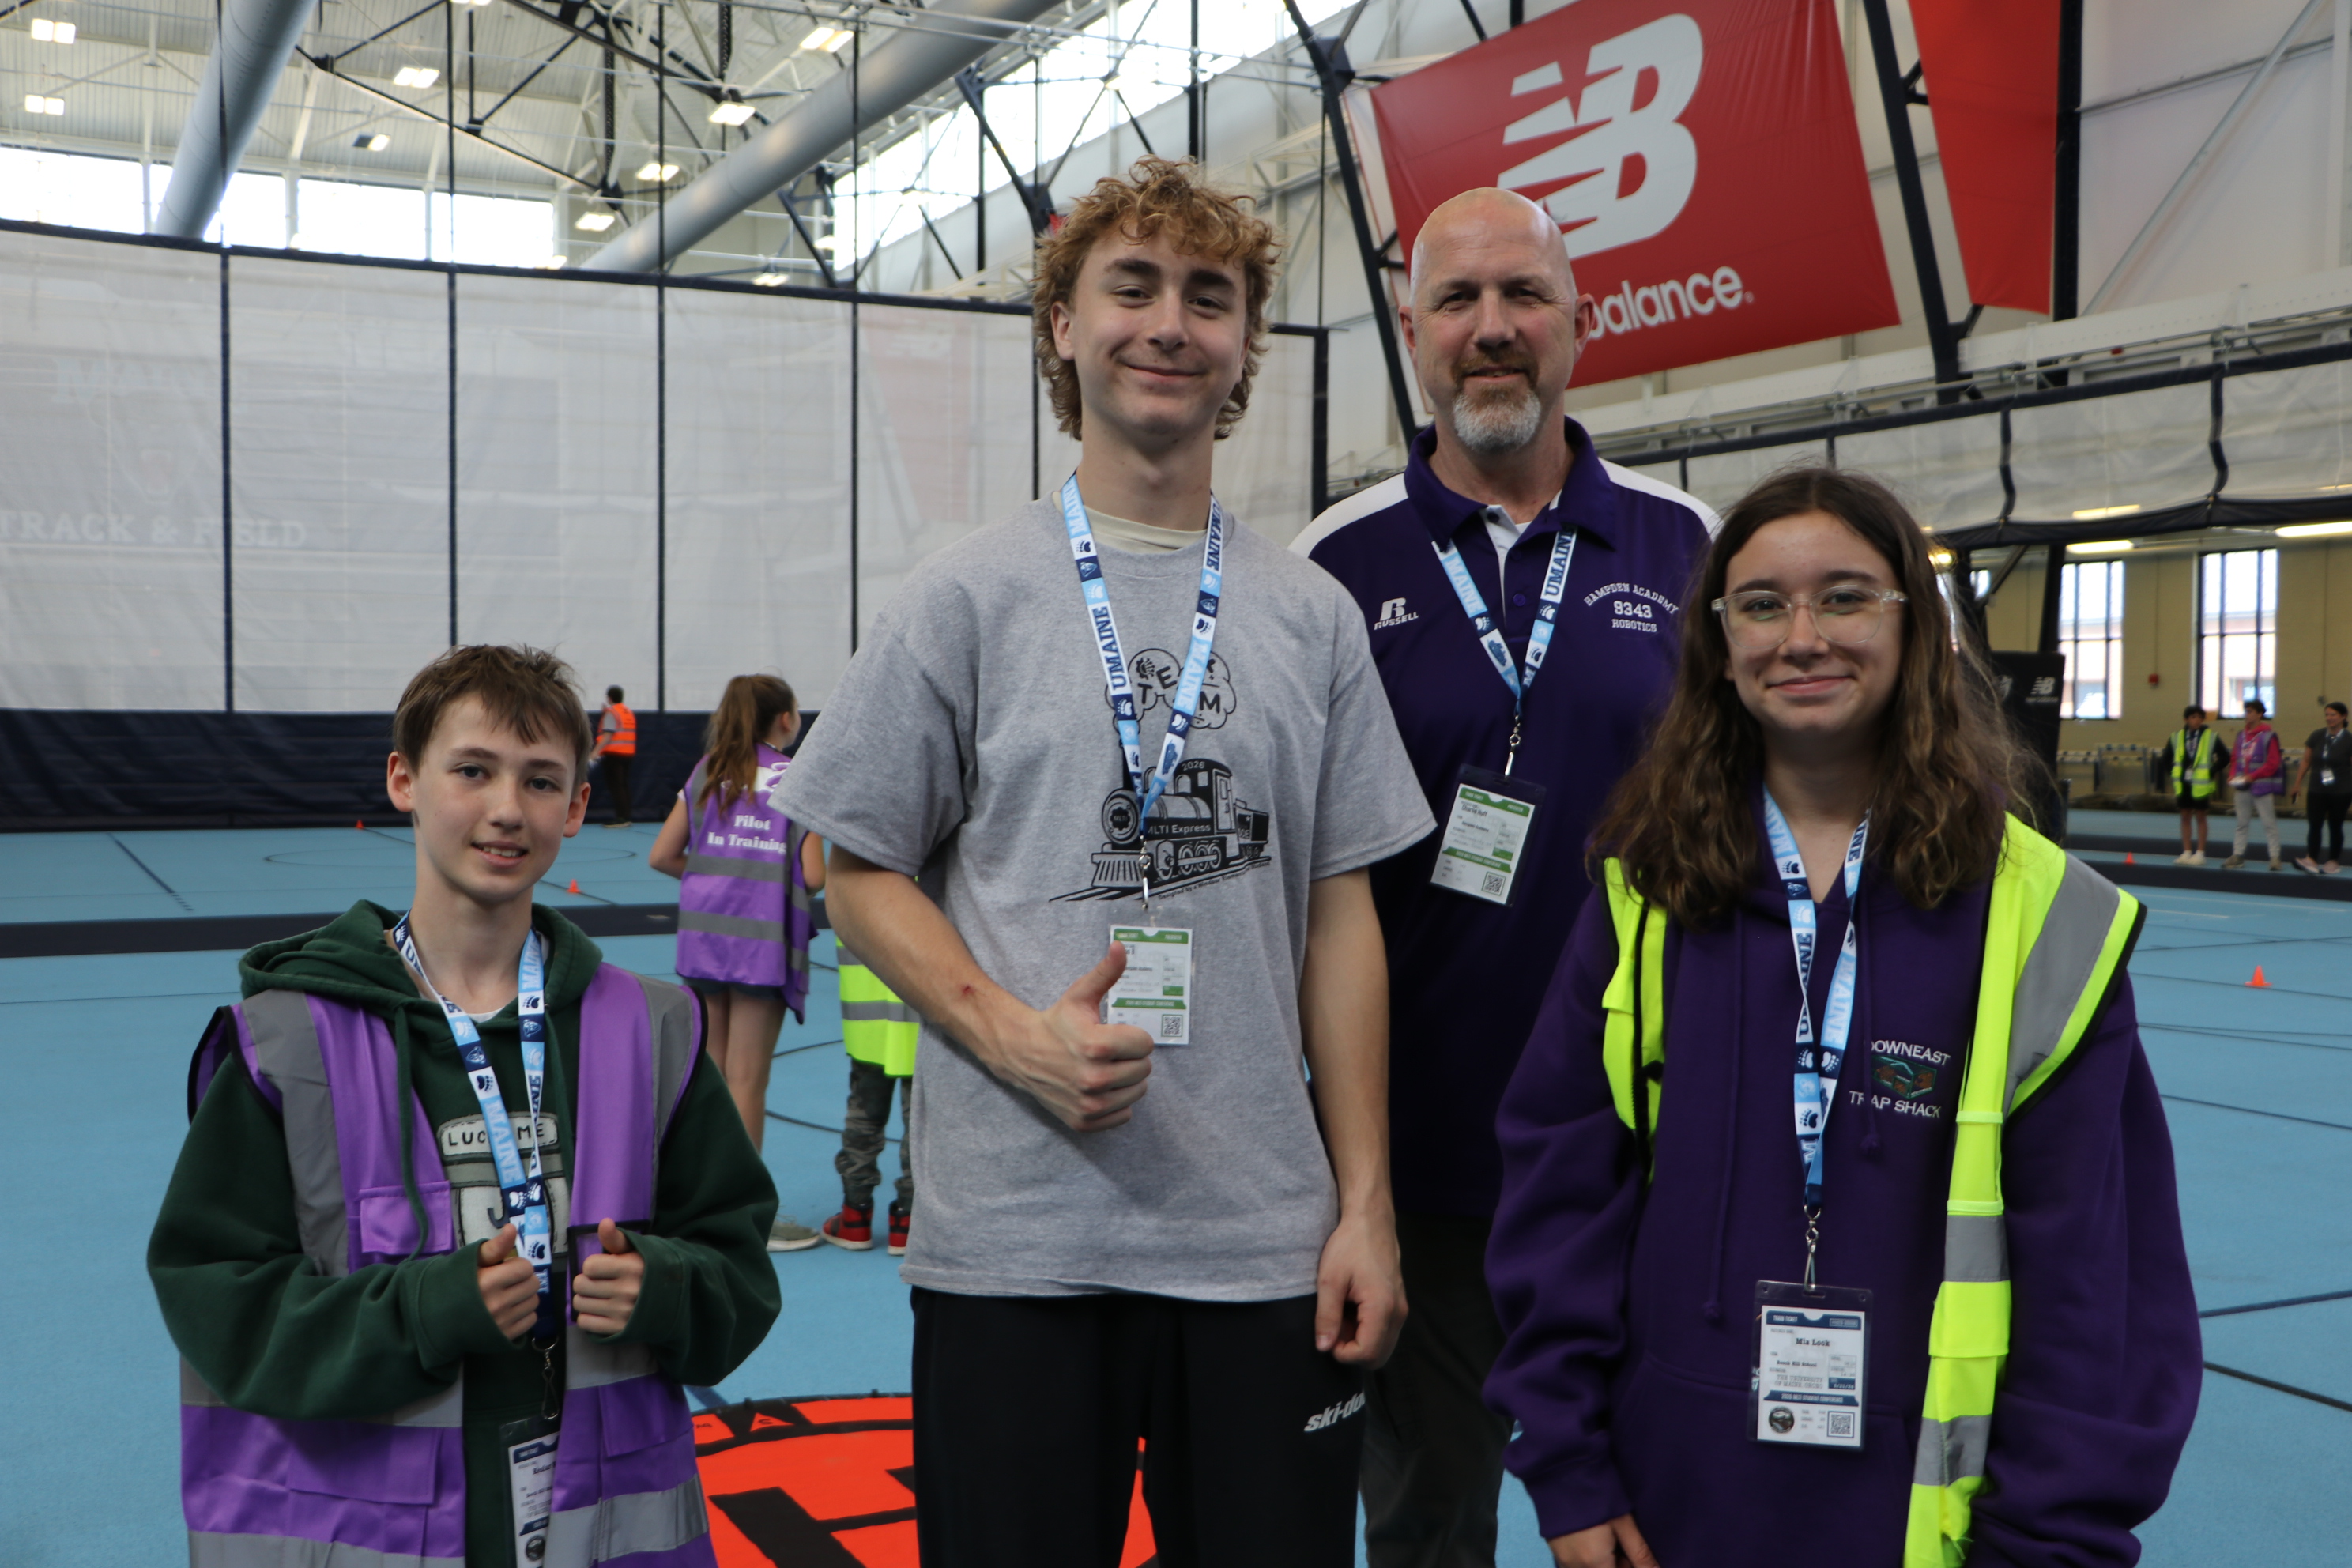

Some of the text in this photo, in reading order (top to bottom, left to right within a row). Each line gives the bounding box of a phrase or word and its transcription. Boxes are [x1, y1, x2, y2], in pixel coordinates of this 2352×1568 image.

[0, 510, 307, 548] TRACK & FELD
[1207, 503, 1222, 571] UMAINE
[1446, 555, 1483, 613] MAINE
[1584, 583, 1679, 615] HAMPDEN ACADEMY
[1613, 600, 1653, 618] 9343
[1374, 612, 1419, 631] RUSSELL
[1611, 618, 1657, 633] ROBOTICS
[1092, 605, 1128, 691] UMAINE
[1175, 637, 1210, 710] MAINE
[1182, 761, 1205, 771] 2026
[733, 815, 771, 831] Pilot
[1171, 824, 1212, 835] Express
[707, 831, 786, 854] In Training
[1824, 957, 1856, 1045] MAINE
[1871, 1039, 1951, 1066] OWNEAST
[1894, 1099, 1941, 1118] SHACK
[484, 1100, 520, 1185] MAINE
[1303, 1392, 1365, 1432] ski-do
